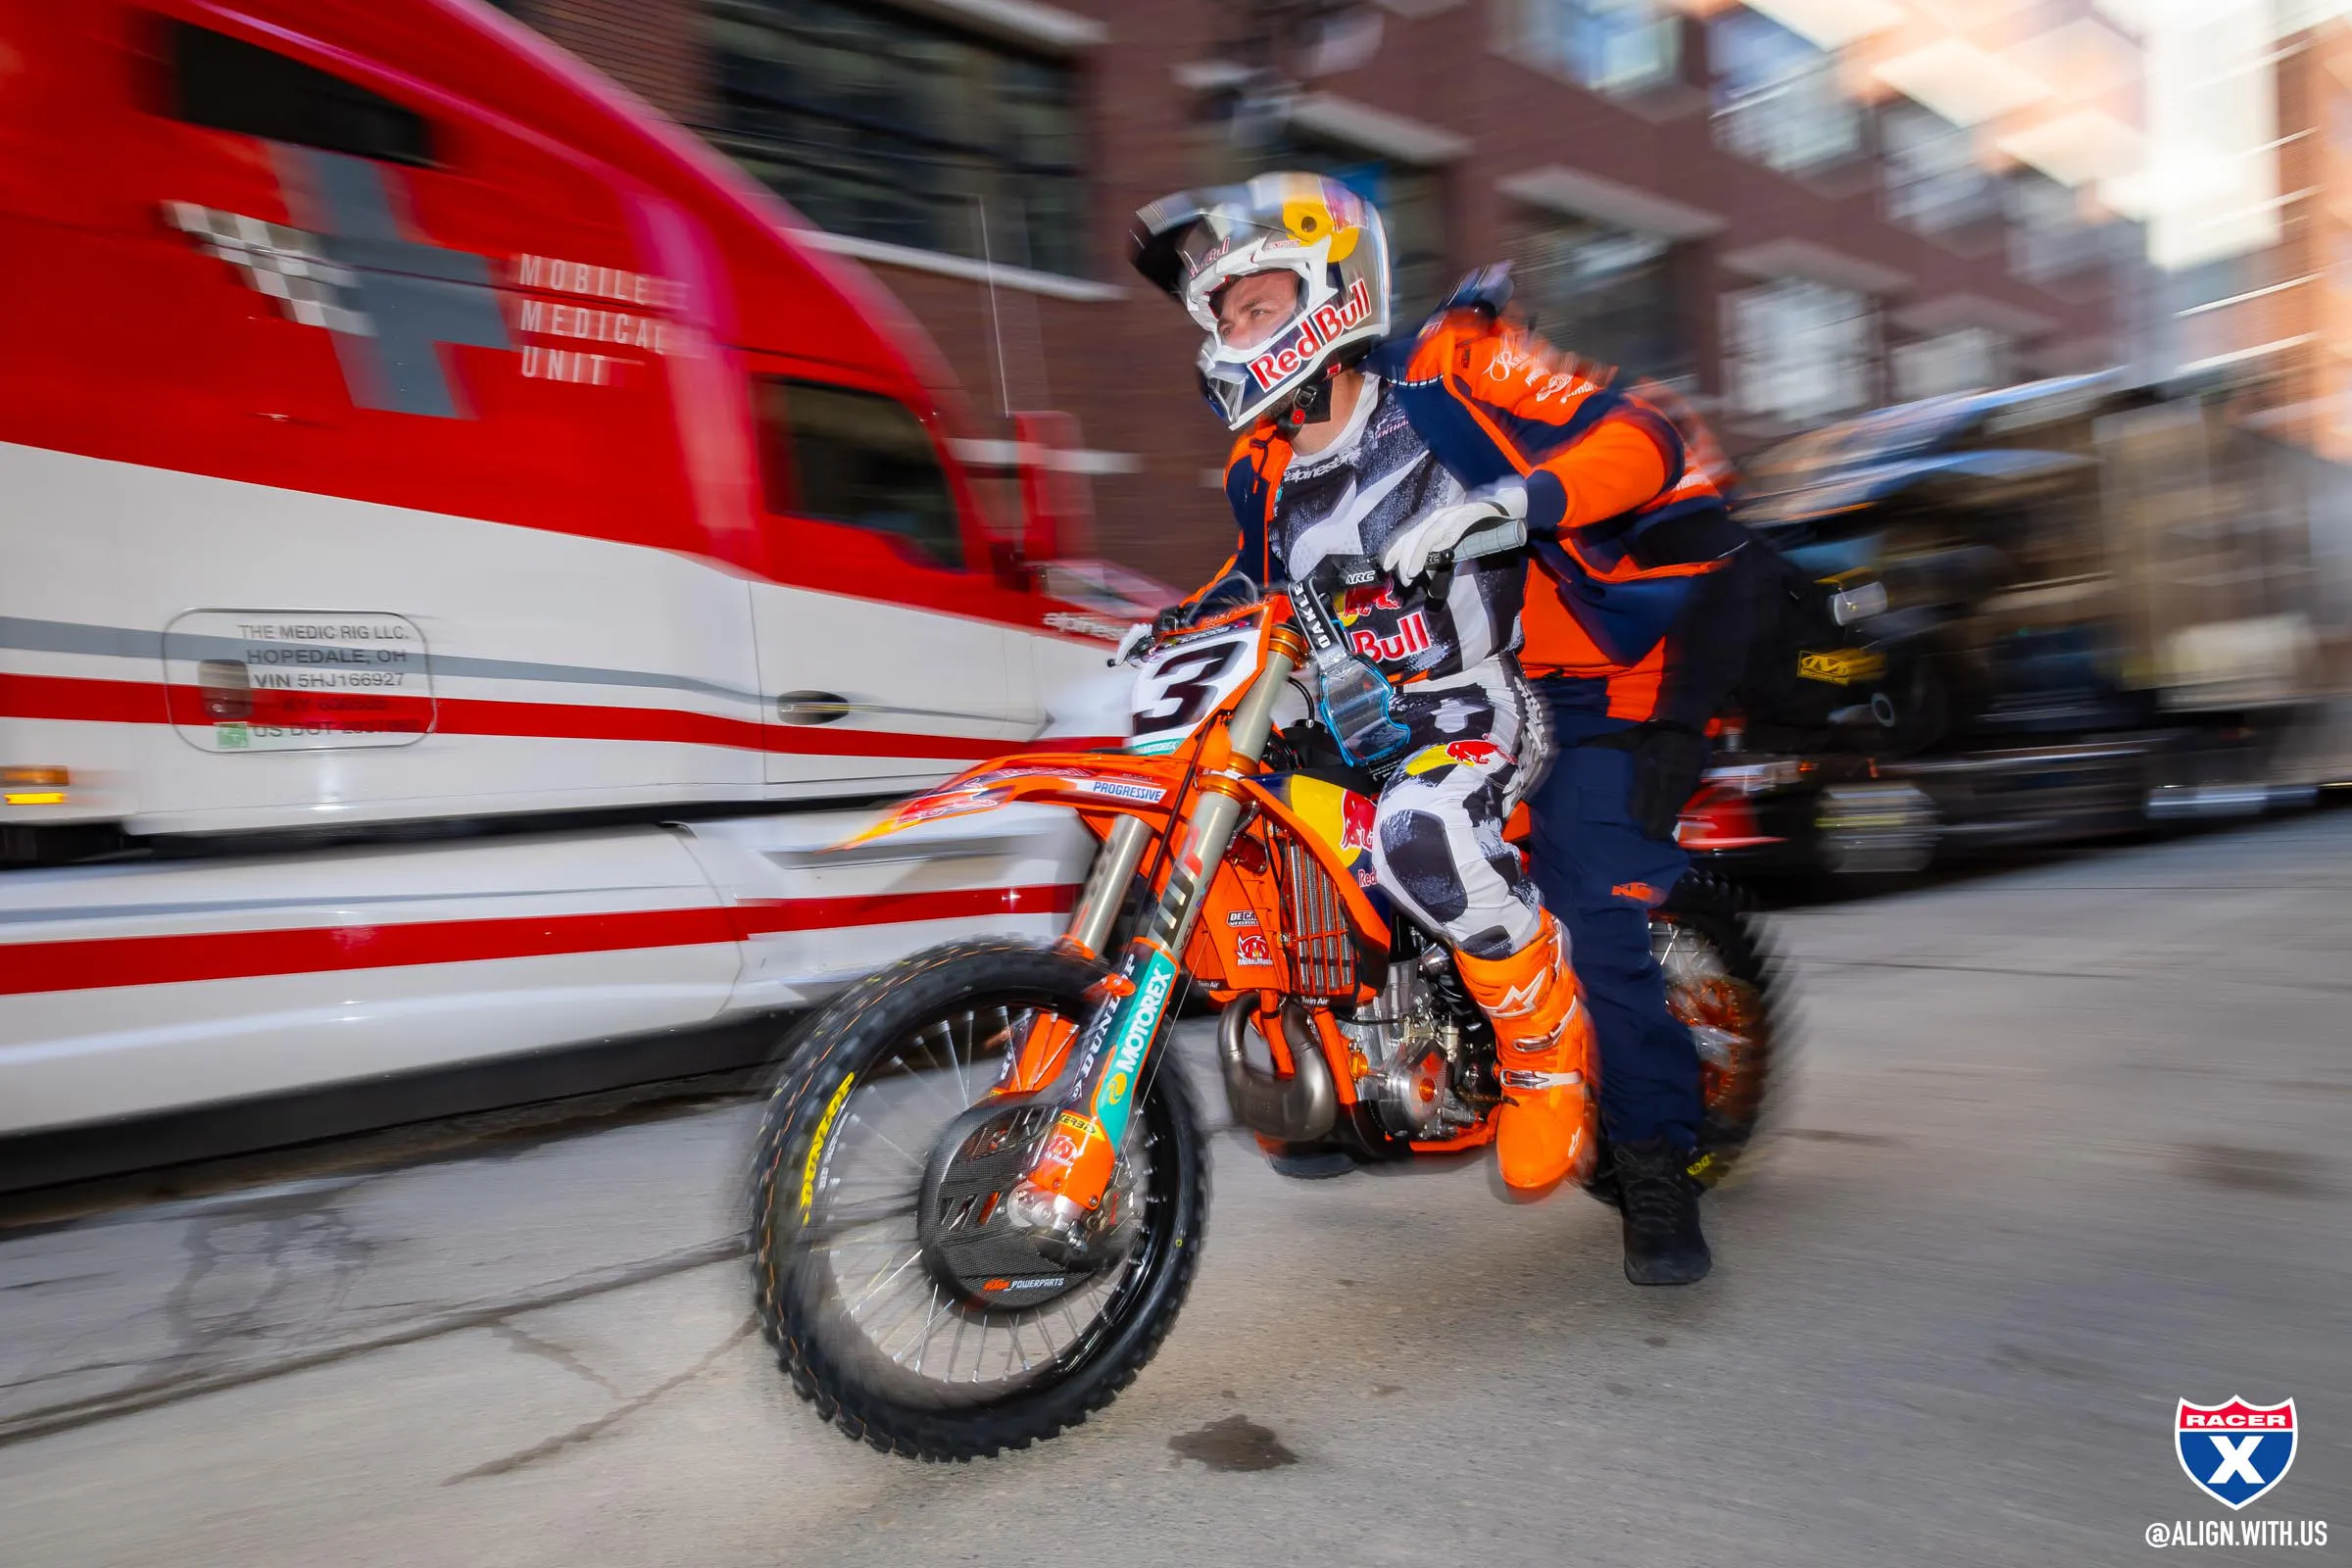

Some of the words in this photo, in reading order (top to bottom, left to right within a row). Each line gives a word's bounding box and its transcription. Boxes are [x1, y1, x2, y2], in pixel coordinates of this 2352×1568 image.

[519, 253, 650, 305] MOBILE
[520, 299, 663, 355] MEDICAL
[1248, 316, 1322, 393] Red
[1310, 278, 1372, 347] Bull
[521, 345, 605, 385] UNIT
[1346, 570, 1376, 585] ARC
[238, 624, 274, 639] THE
[279, 625, 335, 639] MEDIC
[341, 625, 369, 639] RIG
[374, 625, 410, 640] LLC.
[1294, 582, 1331, 649] OAKLE
[1351, 611, 1432, 663] Bull
[247, 648, 371, 665] HOPEDALE,
[376, 649, 407, 663] OH
[254, 673, 291, 688] VIN
[1133, 641, 1248, 736] 3
[1093, 781, 1163, 802] PROGRESSIVE
[1358, 867, 1378, 887] Red
[1081, 954, 1136, 1078] DUNLP
[1116, 967, 1172, 1073] MOTOREX
[1301, 996, 1316, 1004] Twin
